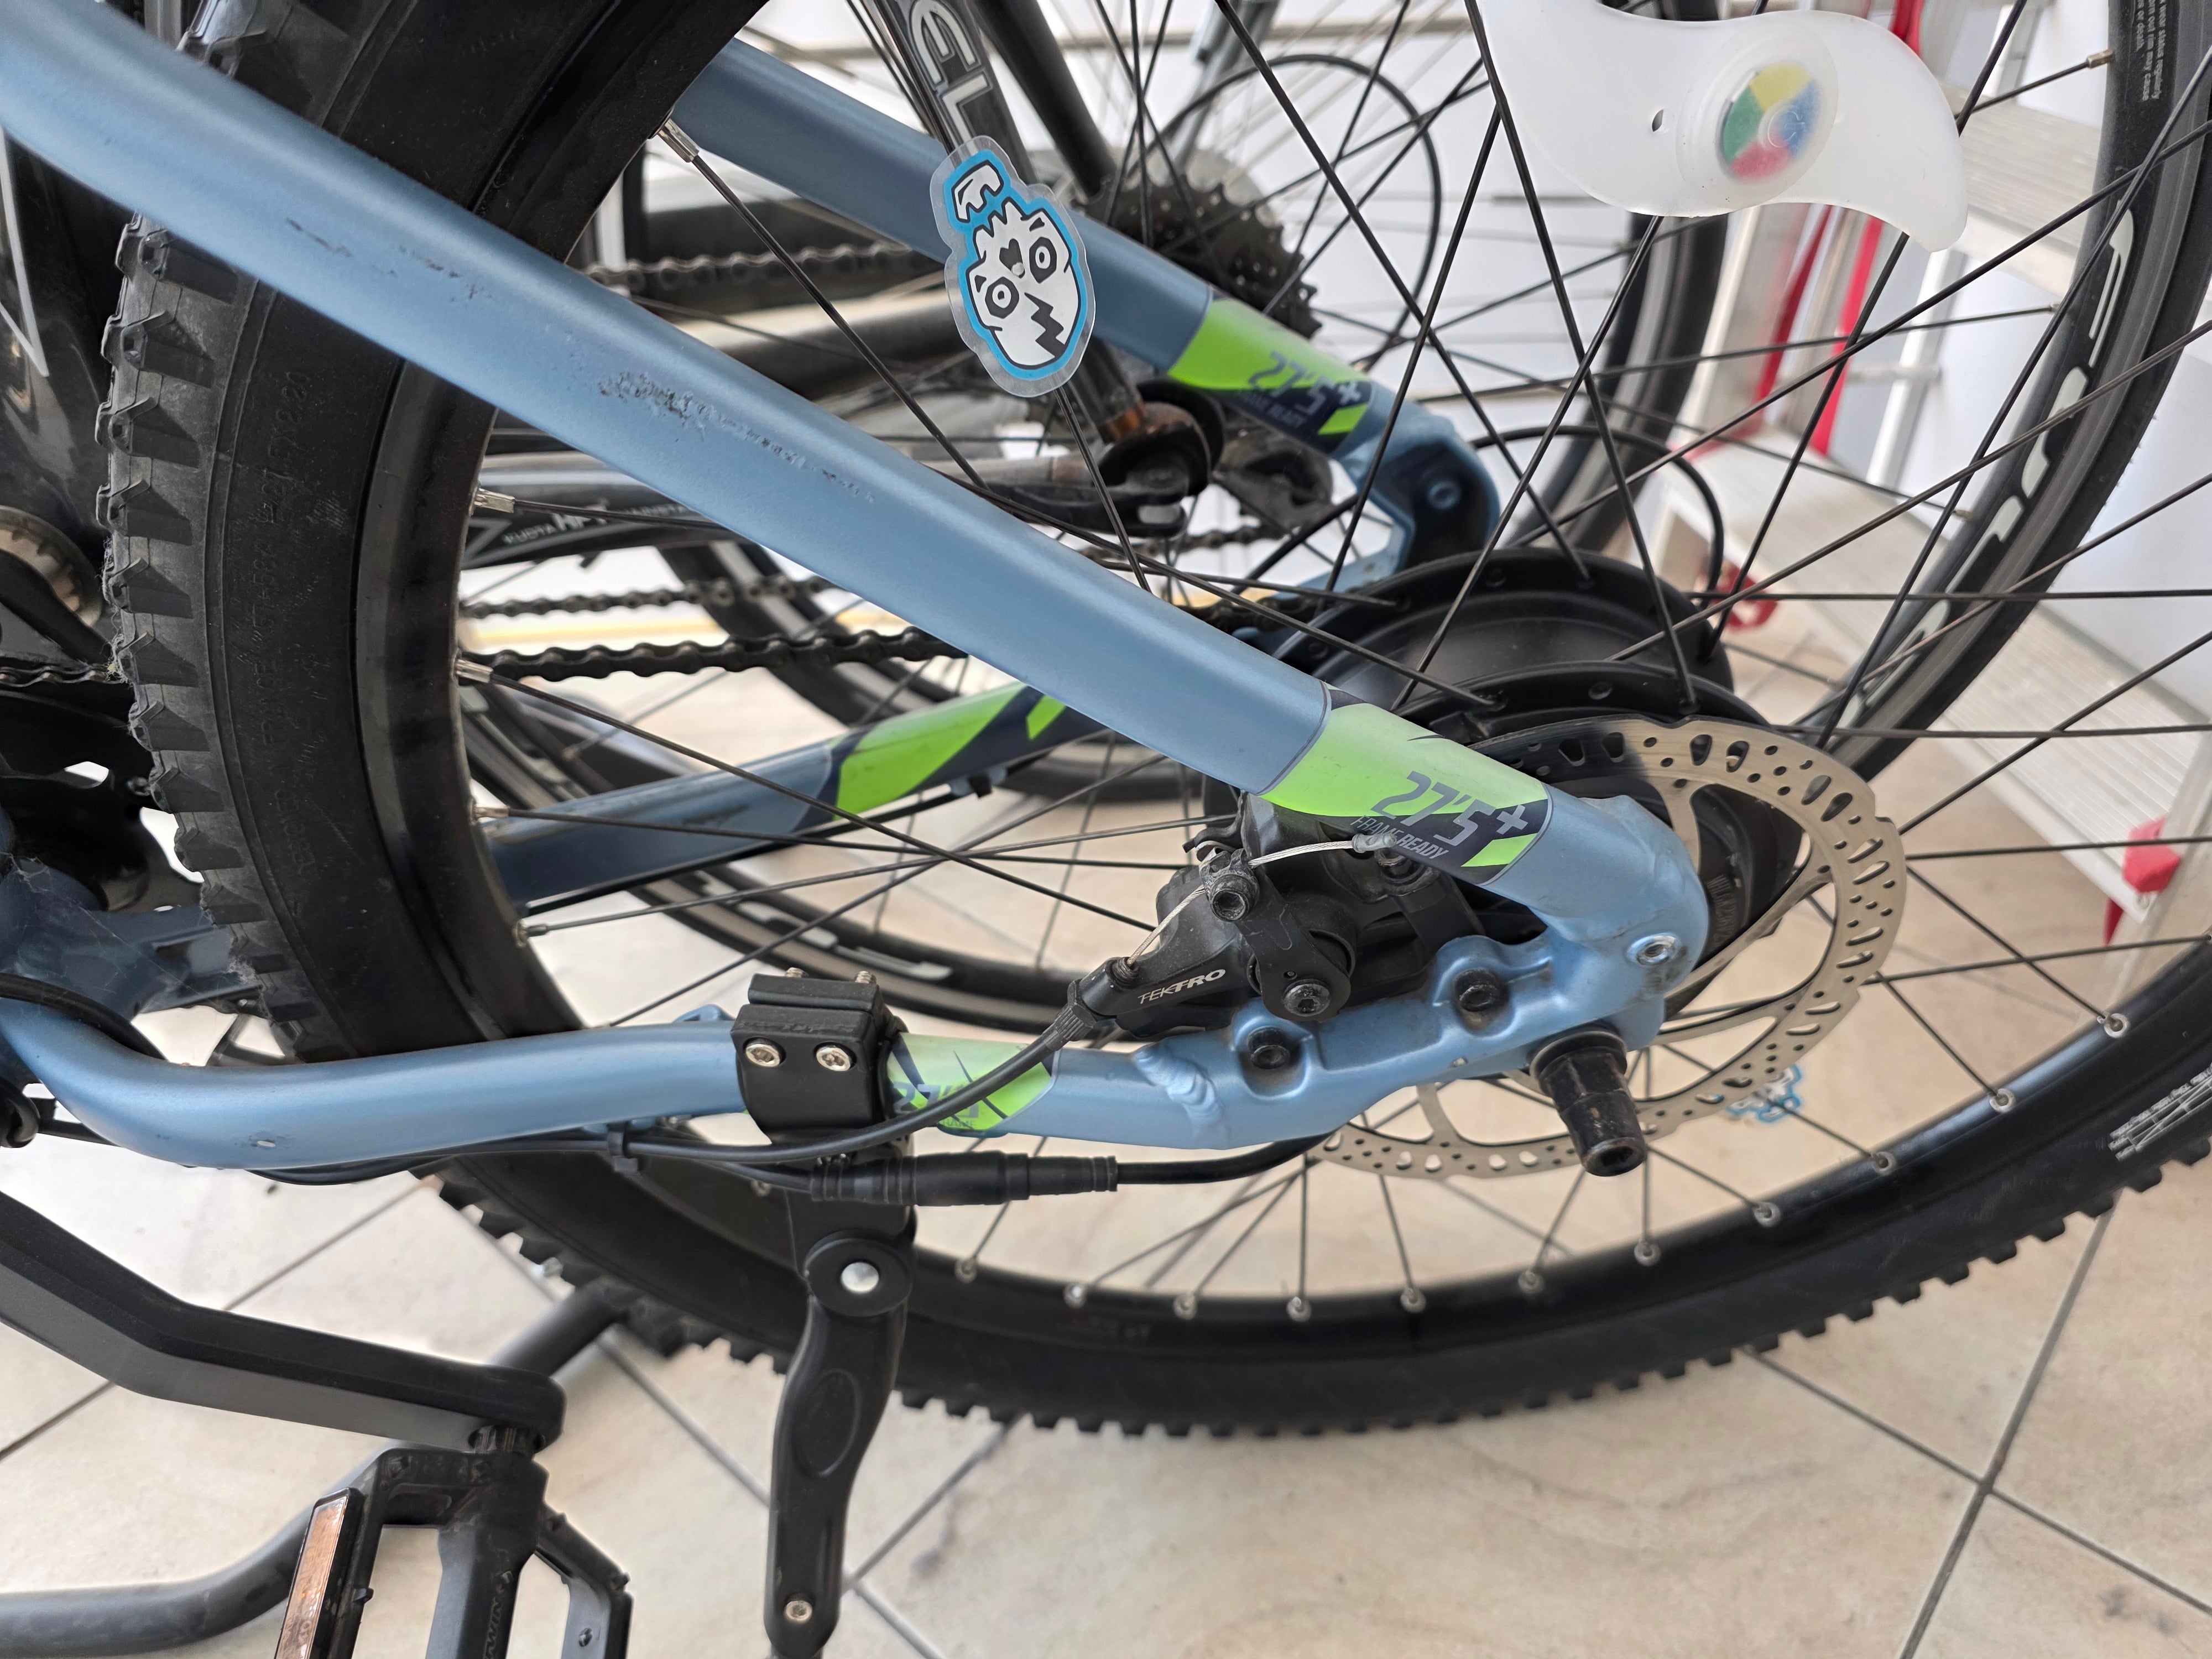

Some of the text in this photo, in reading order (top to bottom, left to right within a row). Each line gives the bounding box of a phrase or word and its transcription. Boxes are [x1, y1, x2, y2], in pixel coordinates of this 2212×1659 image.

[1370, 770, 1528, 847] 27'5+
[1396, 833, 1449, 859] READY
[1138, 969, 1226, 1004] TEKTRO
